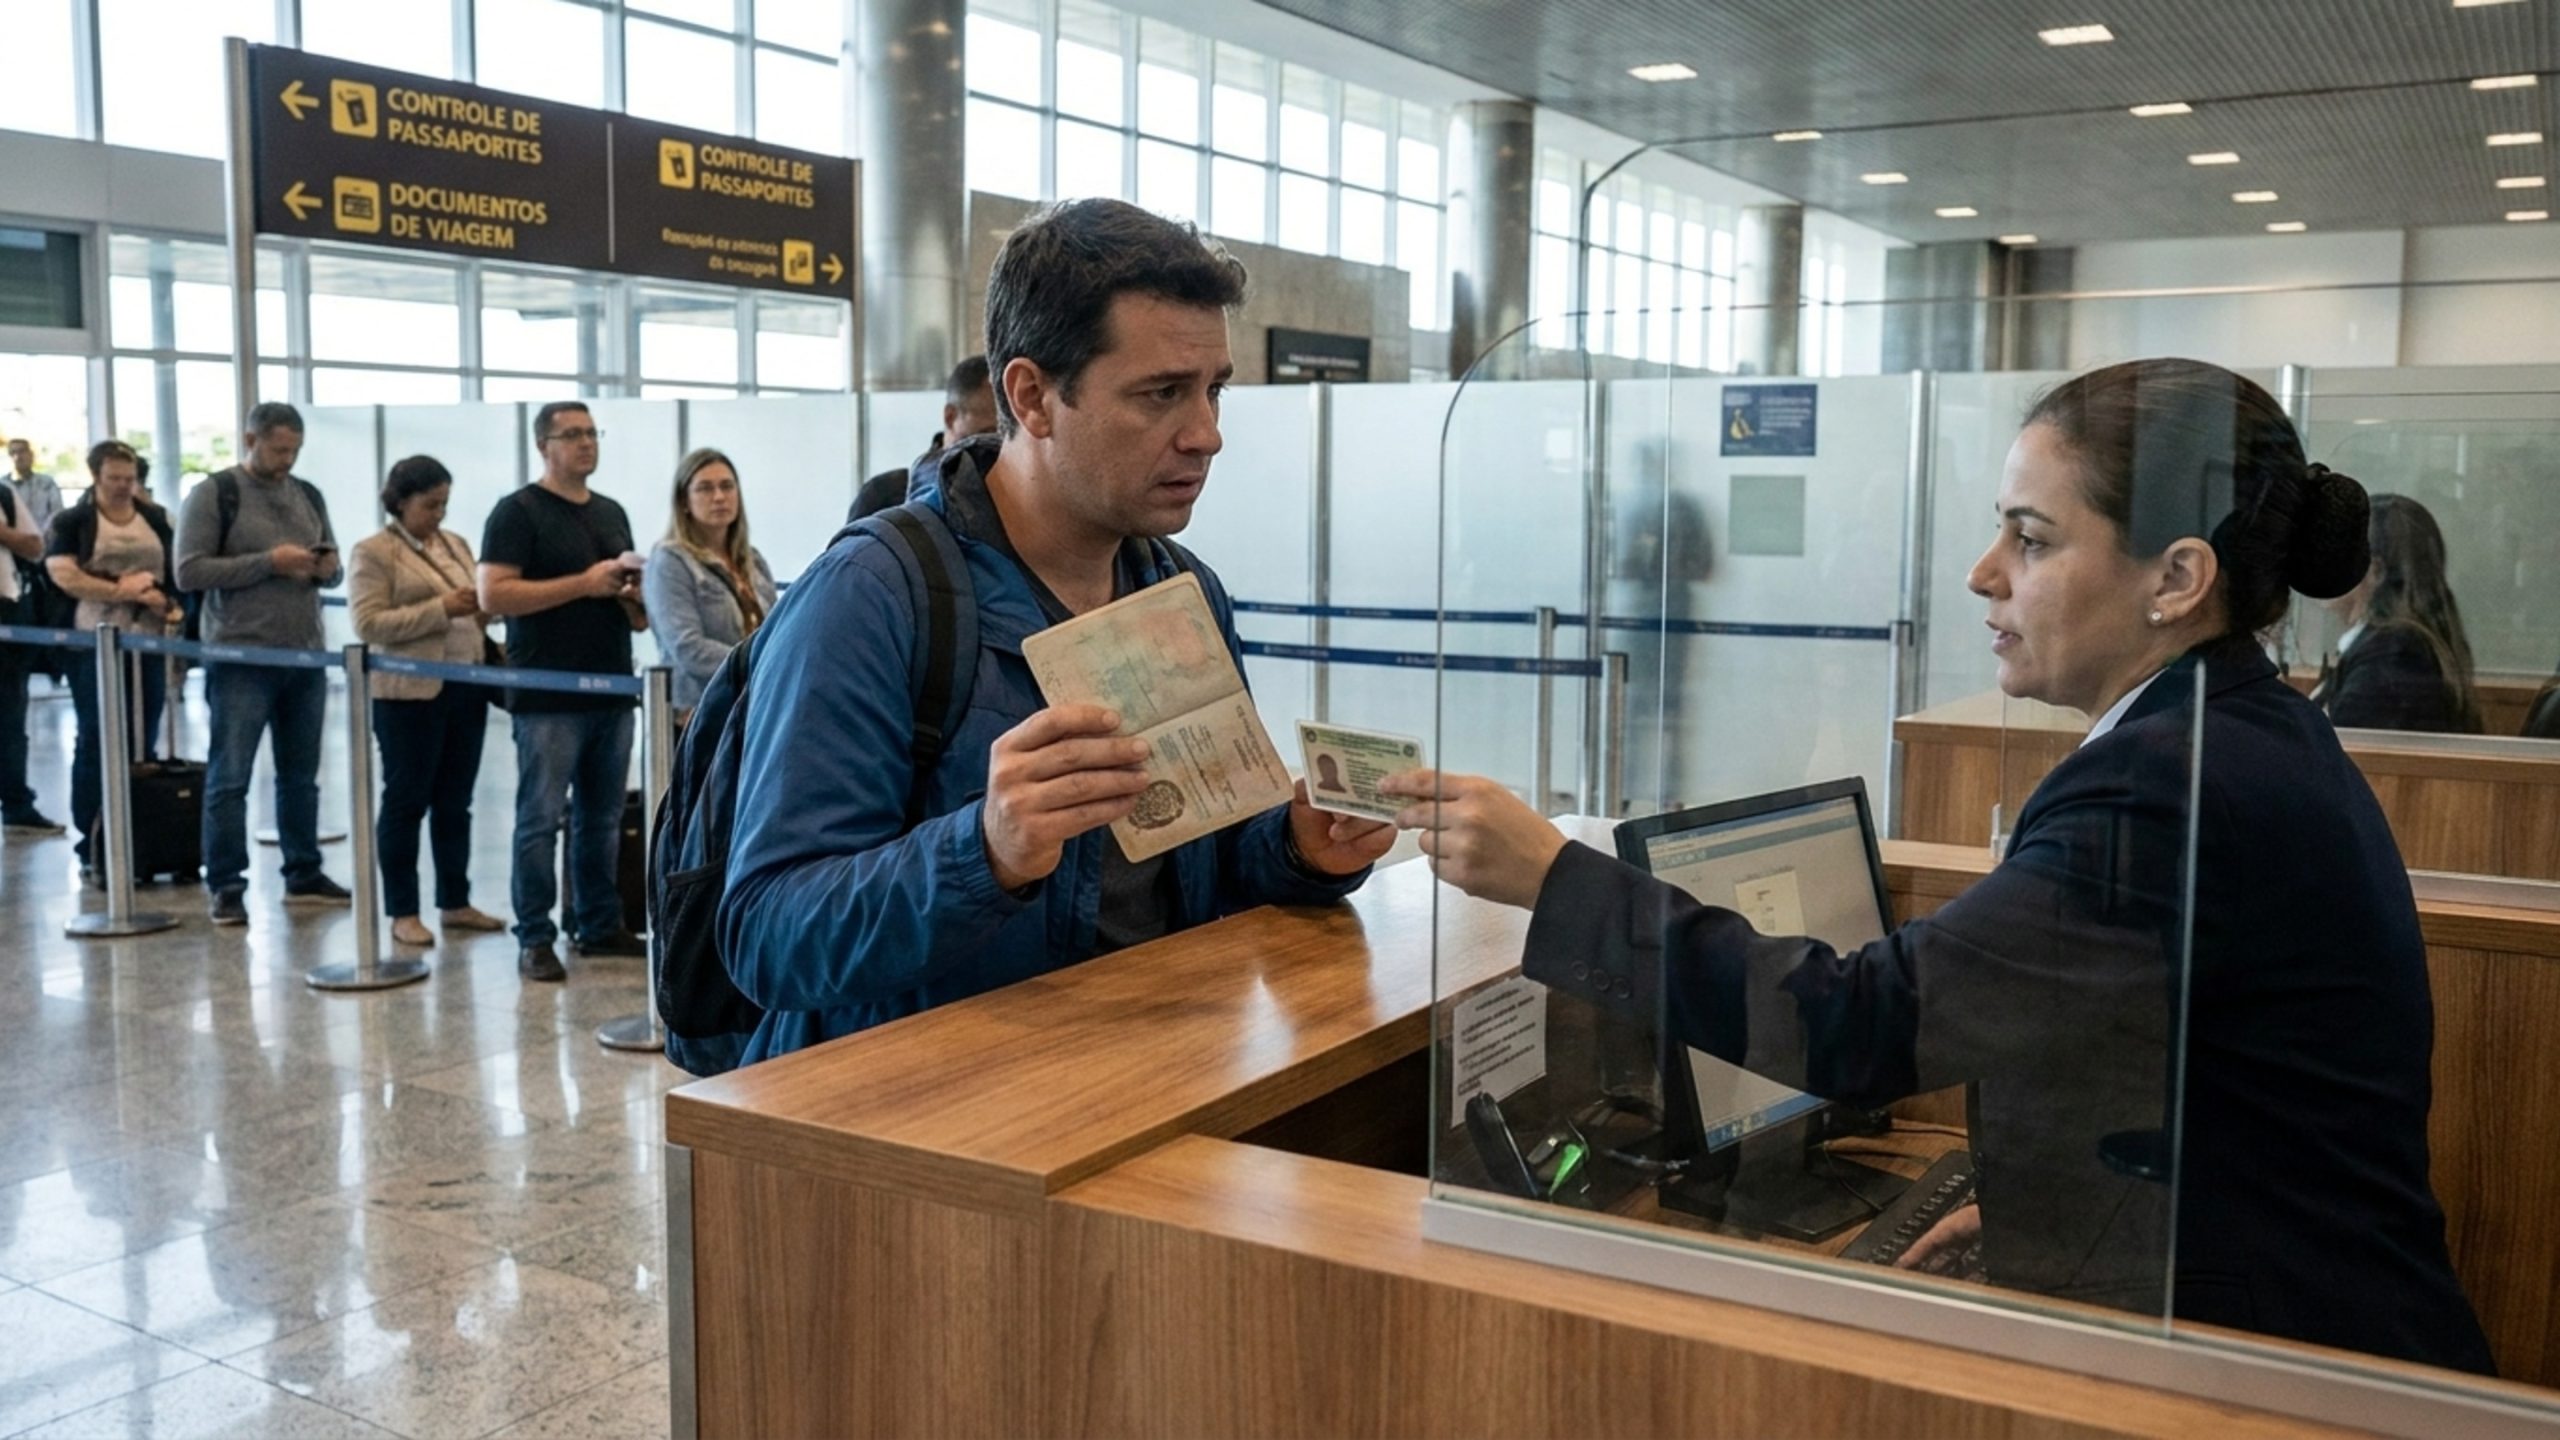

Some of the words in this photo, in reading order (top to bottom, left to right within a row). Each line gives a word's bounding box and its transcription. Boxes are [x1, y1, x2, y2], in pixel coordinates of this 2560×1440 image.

[387, 87, 507, 130] CONTROLE
[512, 109, 541, 135] DE
[388, 118, 543, 164] PASSAPORTES
[700, 144, 788, 179] CONTROLE
[791, 161, 813, 184] DE
[390, 183, 548, 225] DOCUMENTOS
[391, 214, 421, 239] DE
[426, 217, 514, 249] VIAGEM
